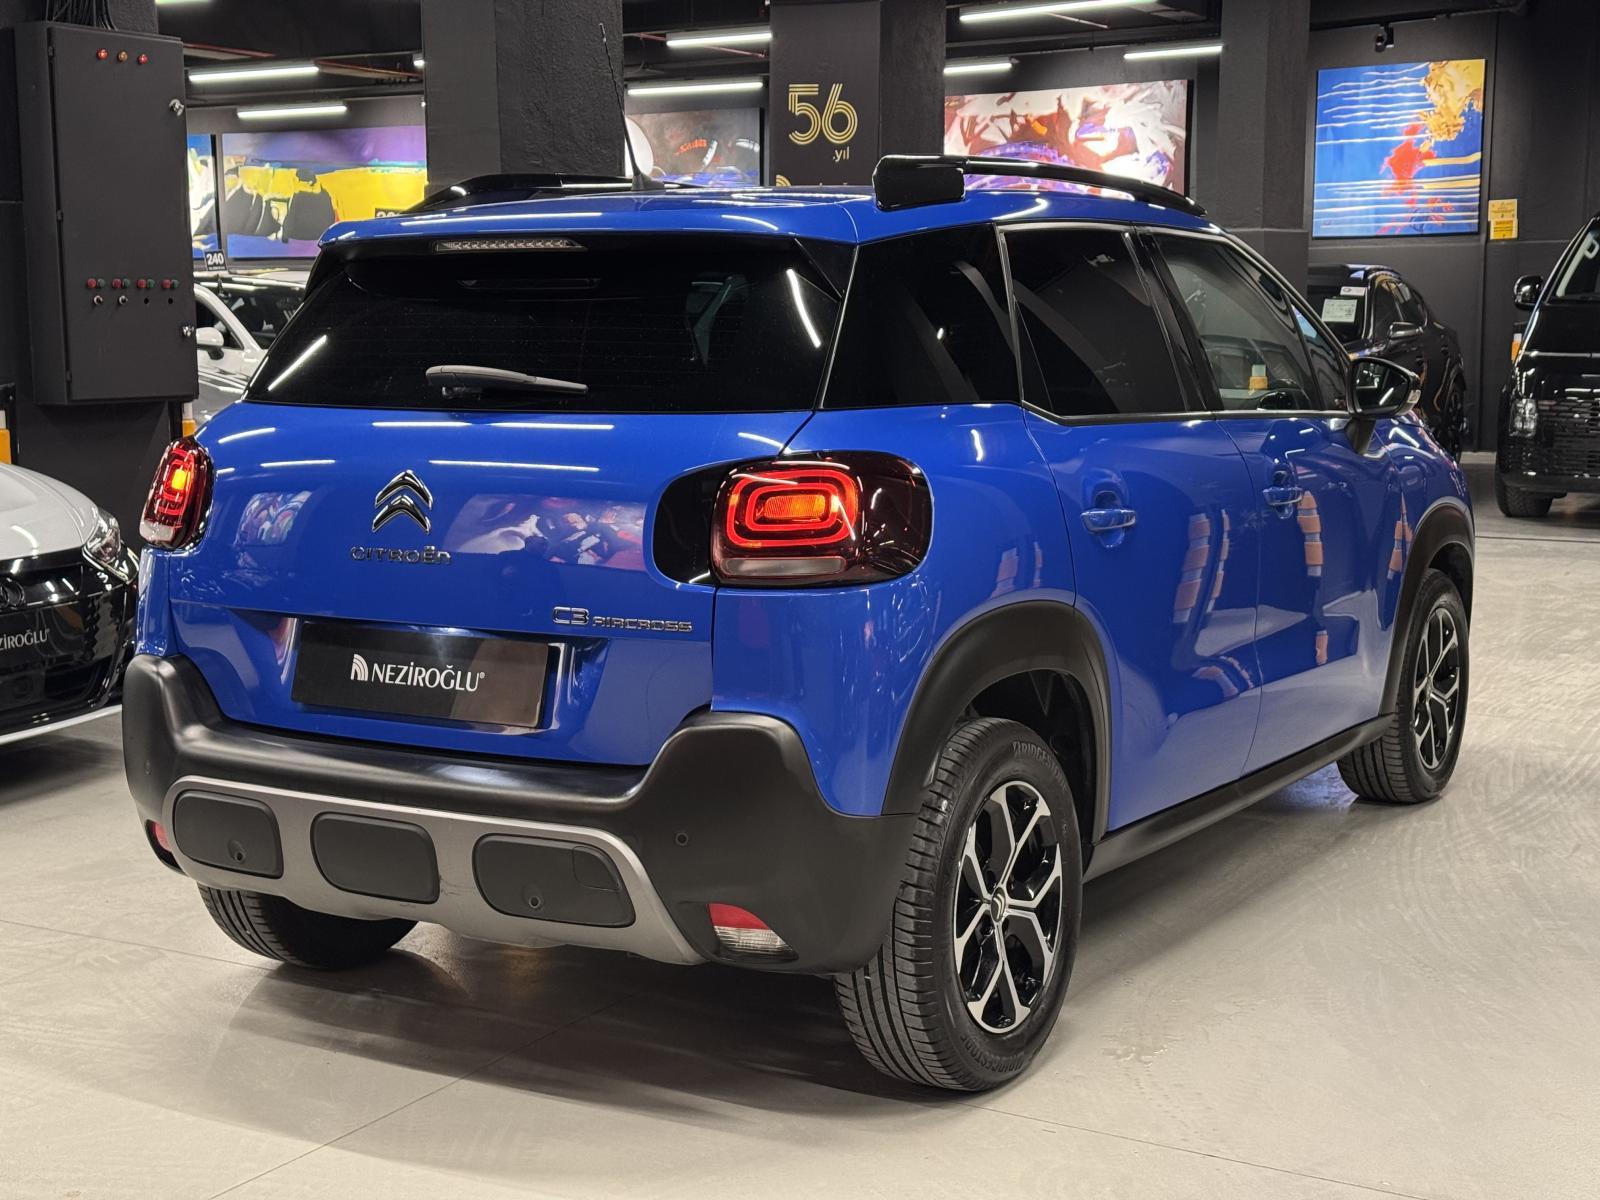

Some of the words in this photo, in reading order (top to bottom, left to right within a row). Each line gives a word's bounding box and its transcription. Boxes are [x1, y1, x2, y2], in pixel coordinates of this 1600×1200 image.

[788, 83, 858, 145] 56
[206, 252, 225, 266] 240
[552, 606, 590, 625] C3
[592, 616, 693, 632] AIRCROSS
